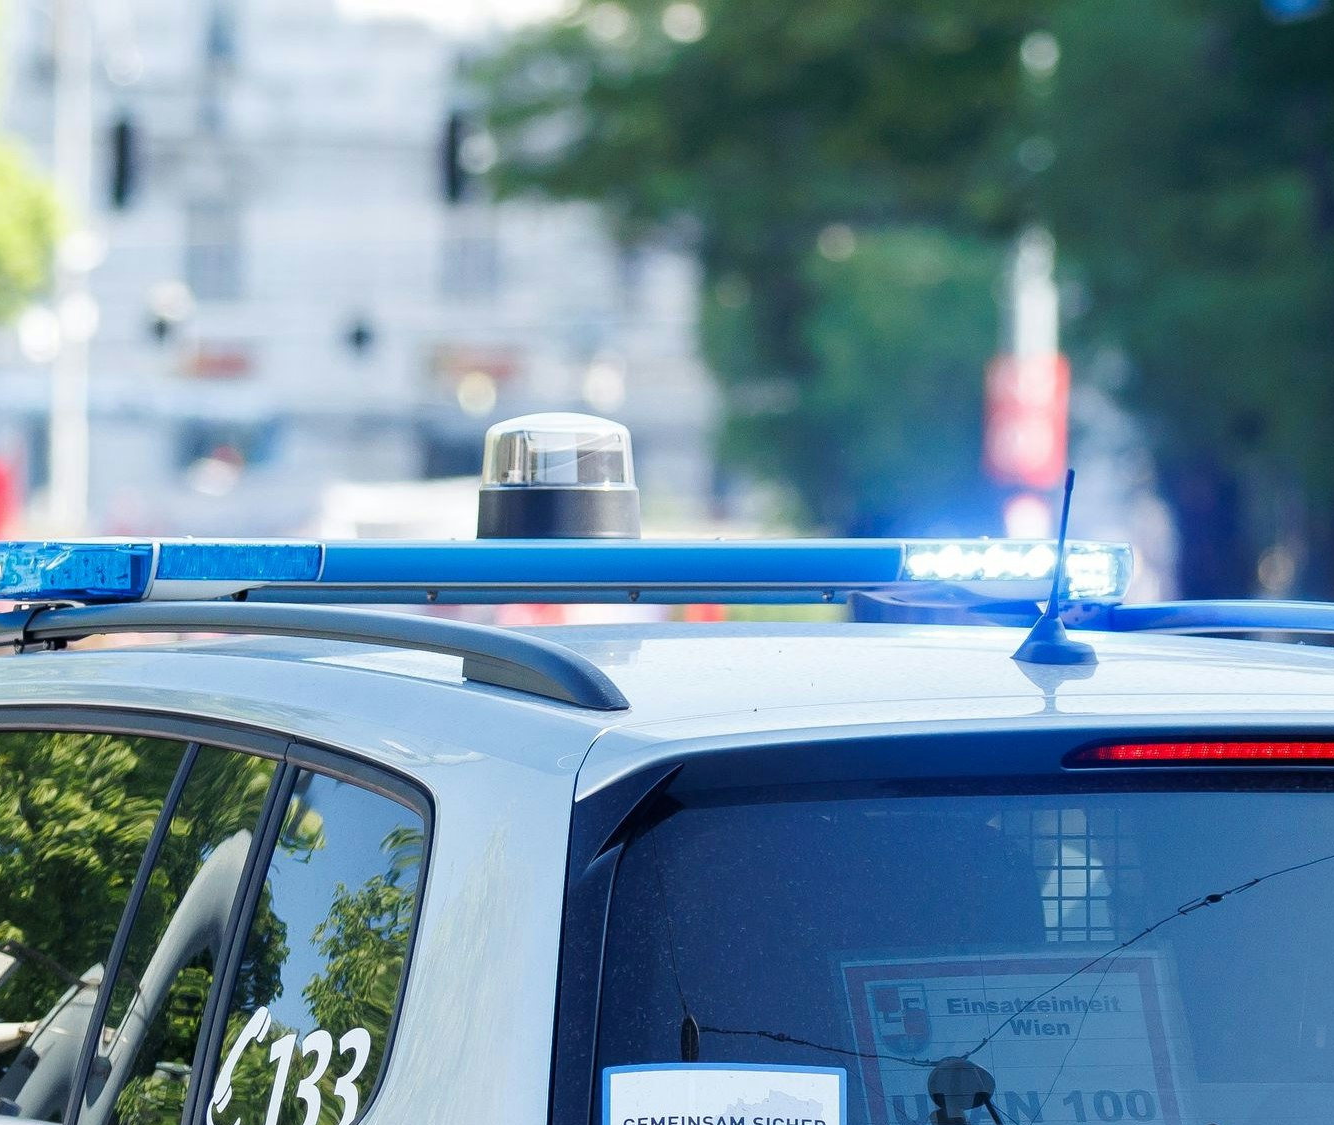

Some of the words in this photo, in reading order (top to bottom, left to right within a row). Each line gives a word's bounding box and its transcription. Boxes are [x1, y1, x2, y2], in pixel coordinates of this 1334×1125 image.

[946, 996, 1122, 1015] Einsatzeinheit
[1009, 1018, 1071, 1037] Wien
[1062, 1089, 1157, 1123] 100
